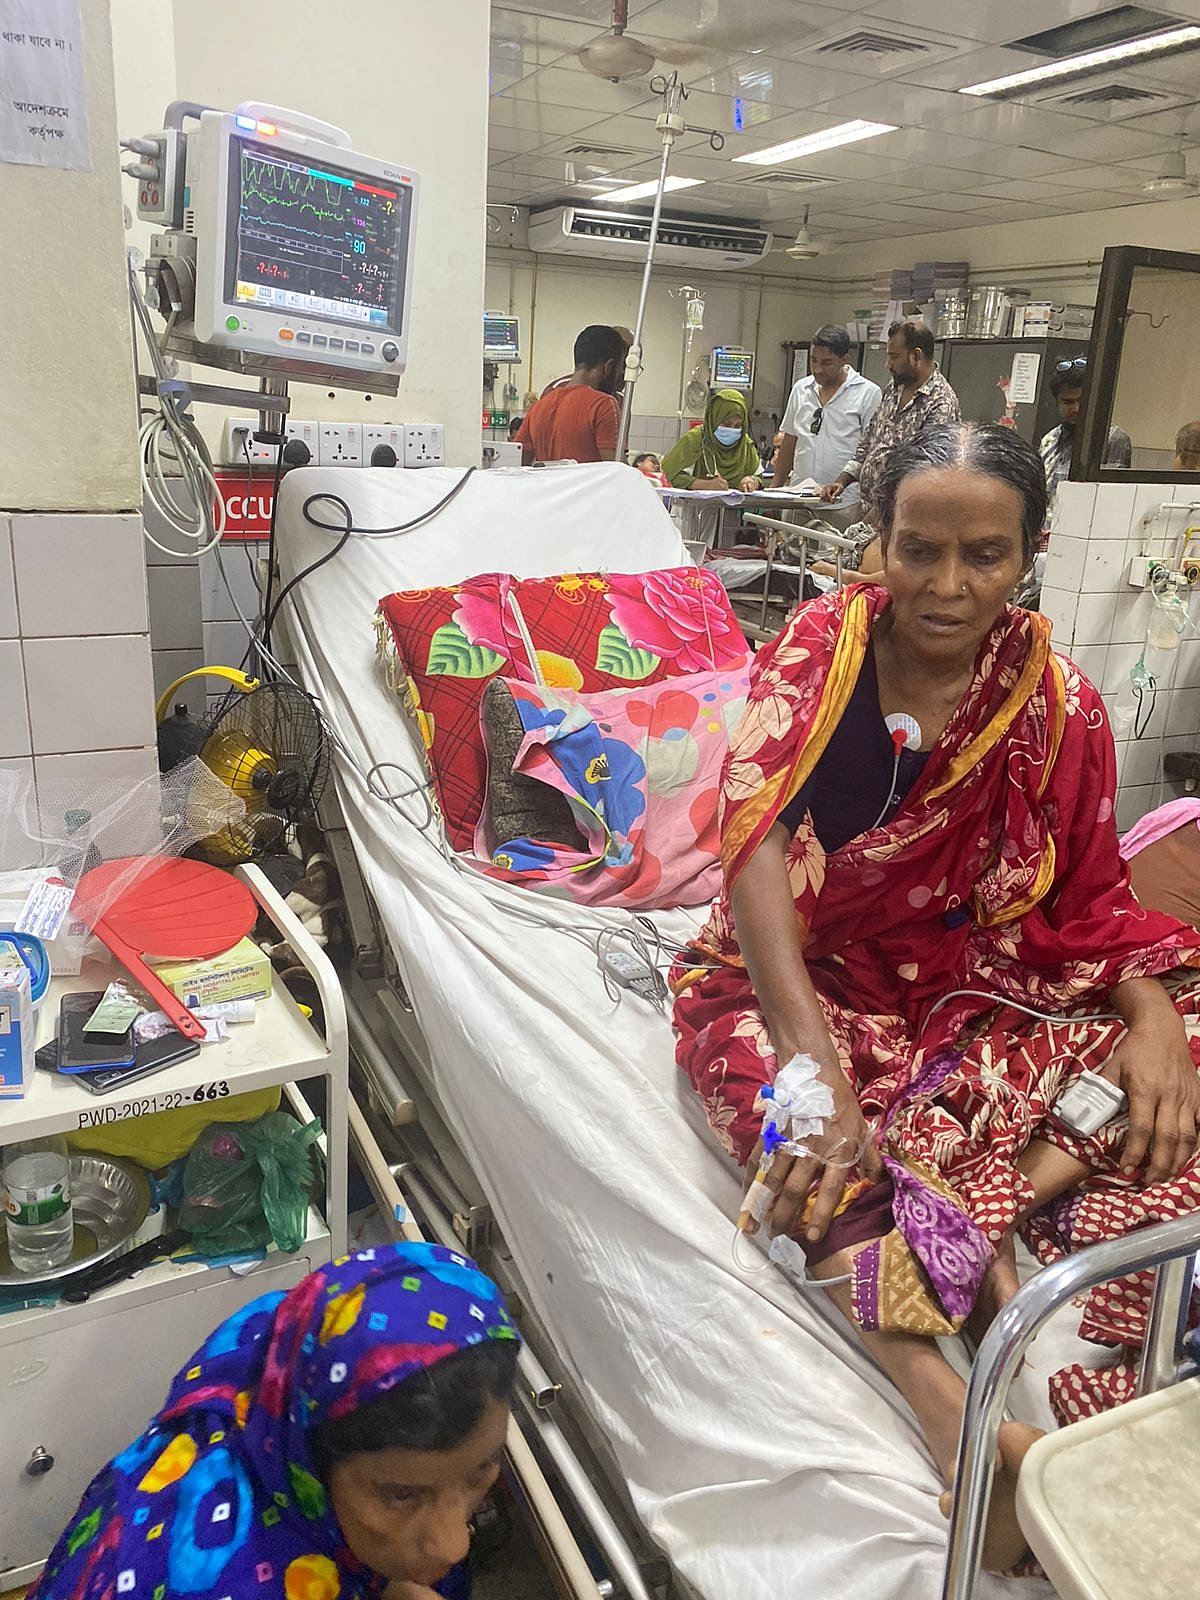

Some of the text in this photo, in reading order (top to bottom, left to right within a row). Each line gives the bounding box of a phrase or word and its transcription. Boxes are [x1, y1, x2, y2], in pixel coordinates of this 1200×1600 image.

[2, 31, 26, 45] থাকা
[28, 35, 51, 48] যাবে
[13, 101, 70, 118] আদেশক্রমে
[27, 124, 65, 141] কর্তৃপক্ষ
[353, 240, 366, 254] 90
[226, 496, 274, 519] CCU
[203, 977, 236, 988] HOSPITALS
[237, 970, 260, 979] LIMITED
